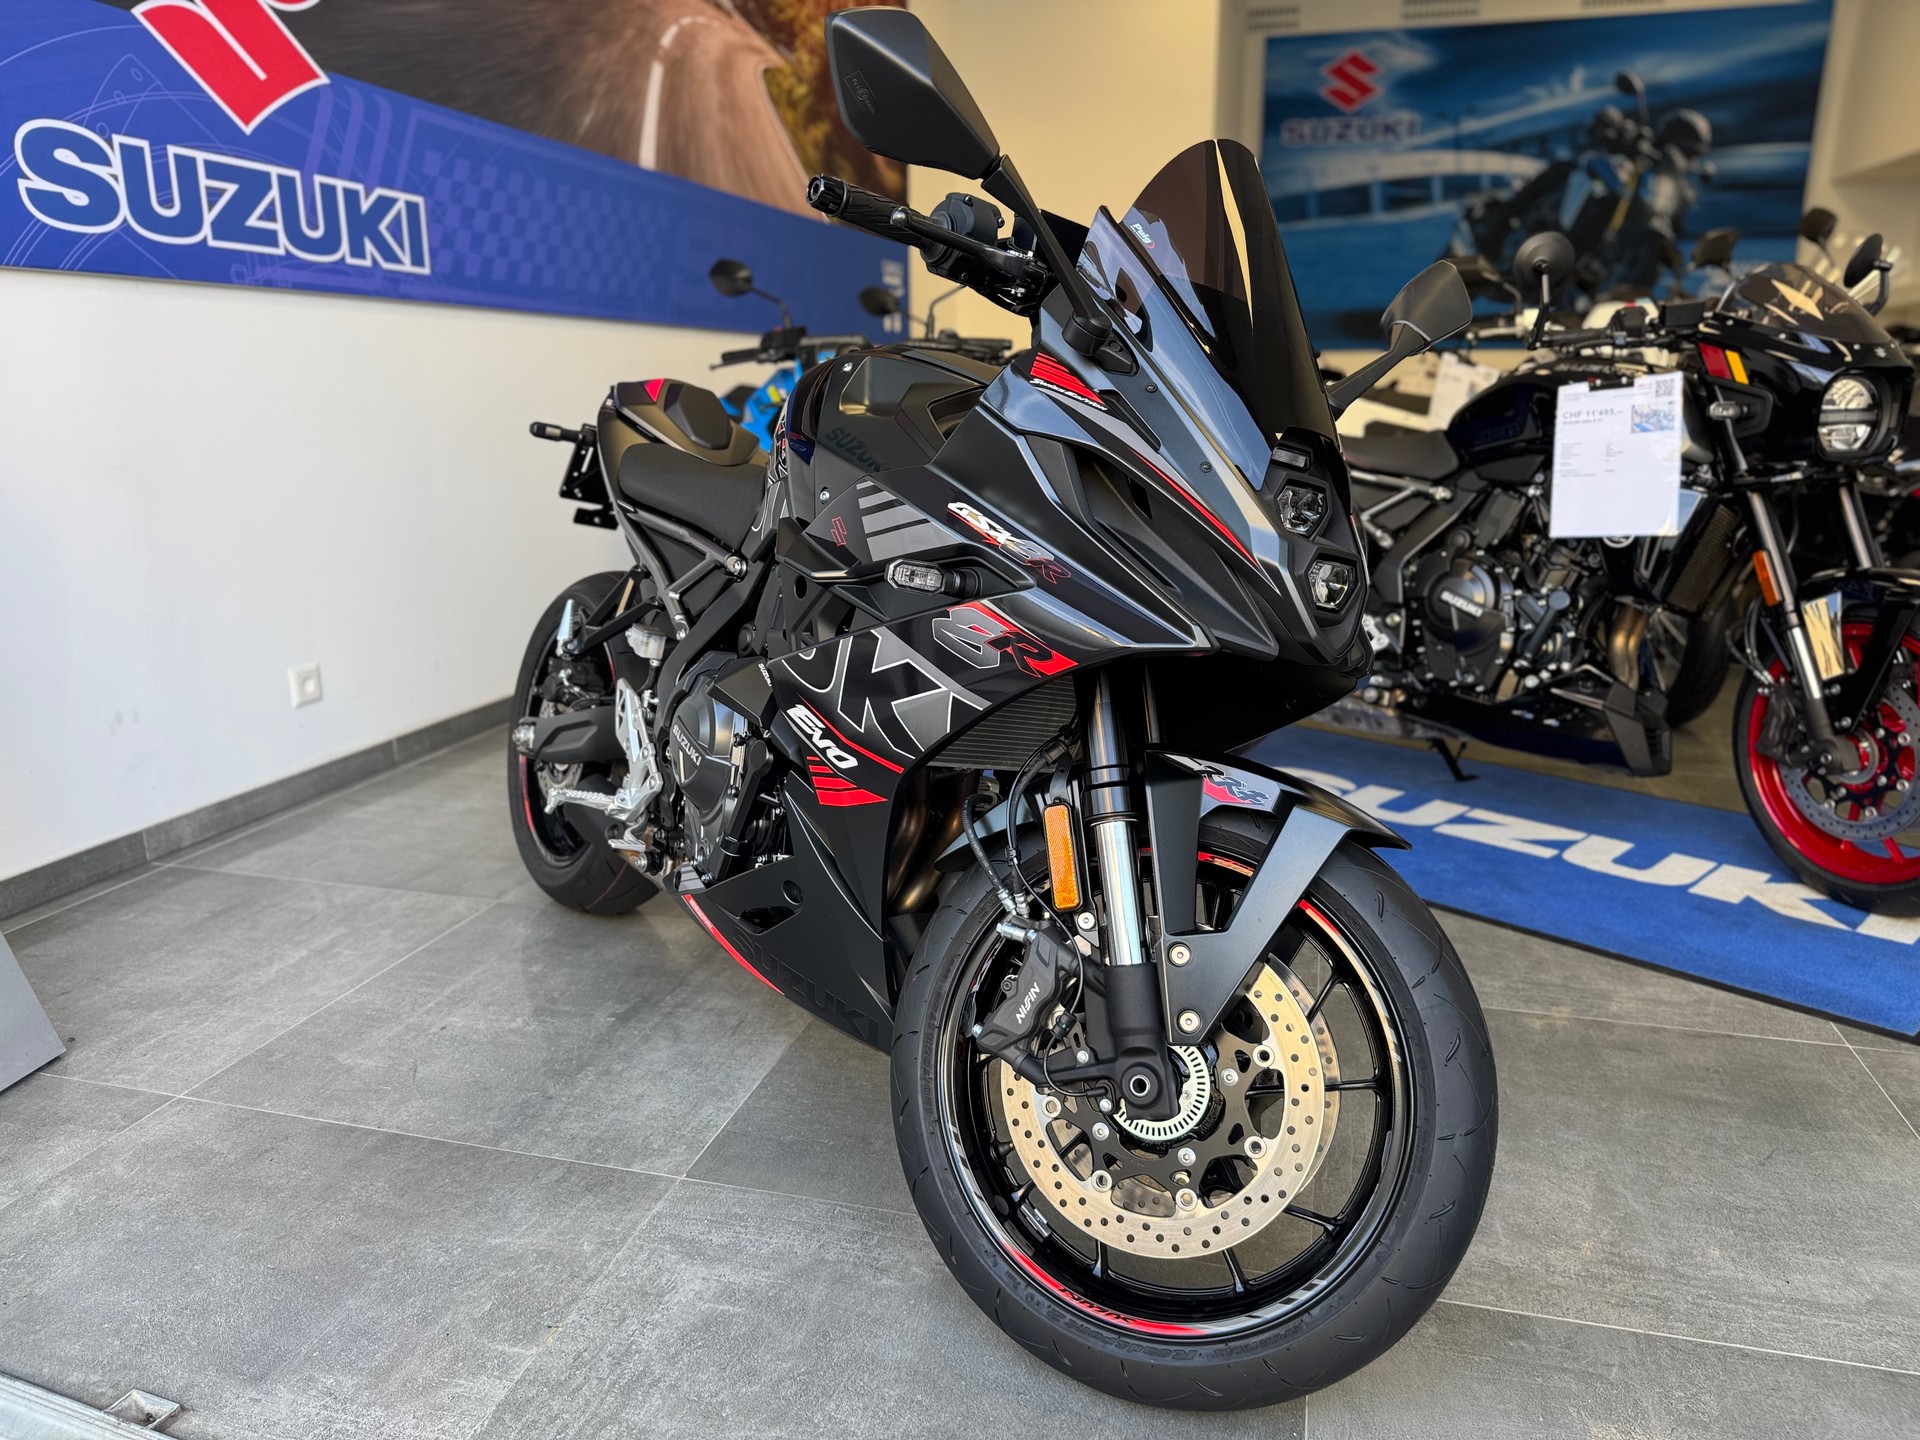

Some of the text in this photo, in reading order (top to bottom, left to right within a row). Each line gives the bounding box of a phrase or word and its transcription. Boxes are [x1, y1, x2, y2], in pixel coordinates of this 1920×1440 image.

[1281, 111, 1421, 148] SUZUKI
[14, 118, 431, 275] SUZUKI
[1130, 223, 1152, 244] Puig
[1440, 590, 1484, 618] SUZUKI
[672, 724, 702, 767] SUZUKI
[786, 703, 859, 769] EVO
[1015, 981, 1040, 1025] NISSIN
